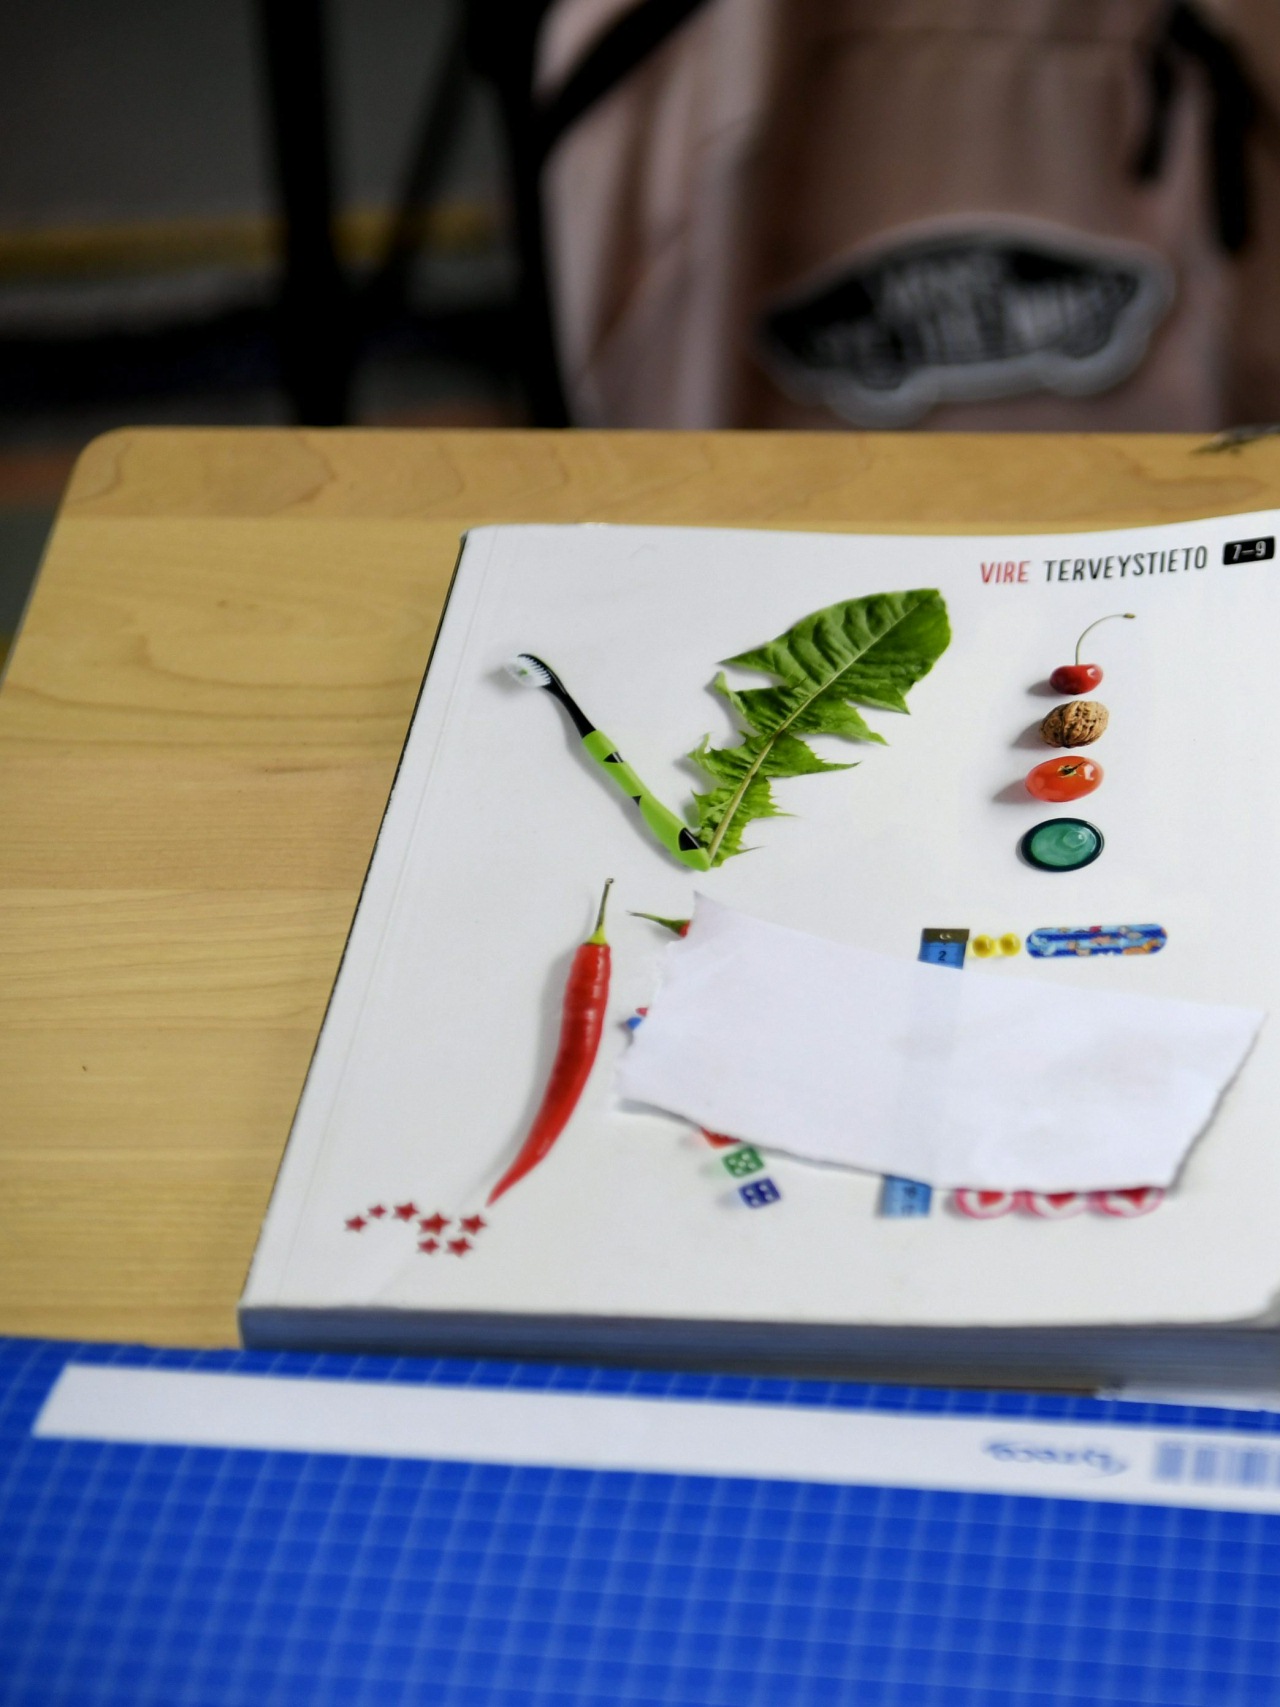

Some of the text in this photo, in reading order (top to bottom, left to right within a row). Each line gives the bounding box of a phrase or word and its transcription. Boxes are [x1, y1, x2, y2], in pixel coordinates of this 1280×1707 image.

[980, 560, 1030, 583] VIRE
[1044, 545, 1207, 582] TERVEYSTIETO
[937, 950, 947, 962] 2
